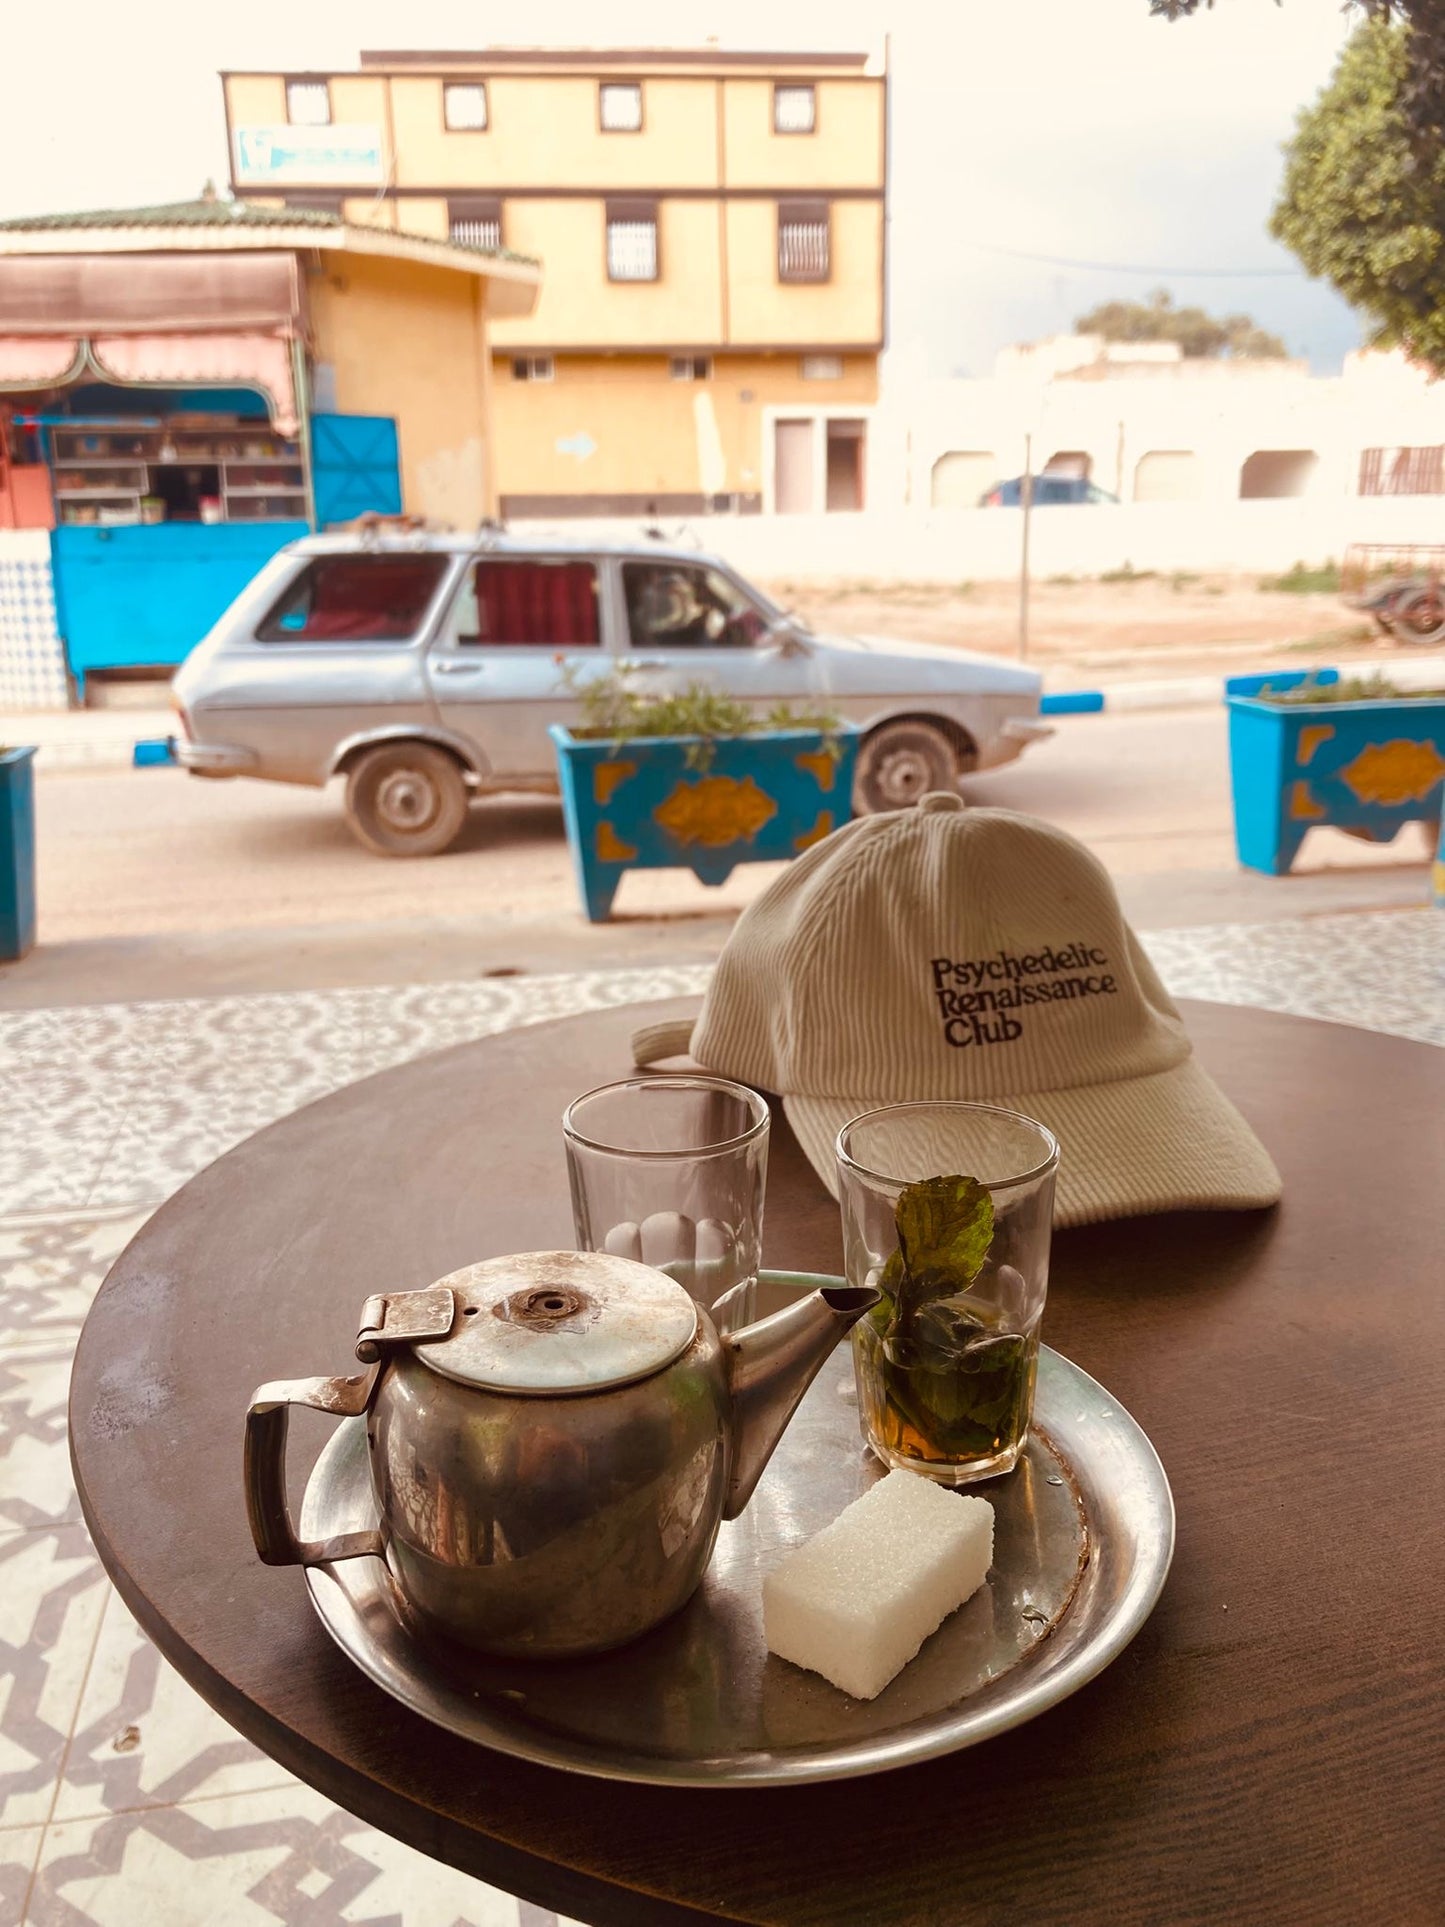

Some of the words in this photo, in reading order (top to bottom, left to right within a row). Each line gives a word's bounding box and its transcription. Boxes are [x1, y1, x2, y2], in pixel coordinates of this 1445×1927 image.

[931, 942, 1107, 989] Psychedelic
[936, 974, 1118, 1019] Renaissance
[944, 1012, 1023, 1048] Club
